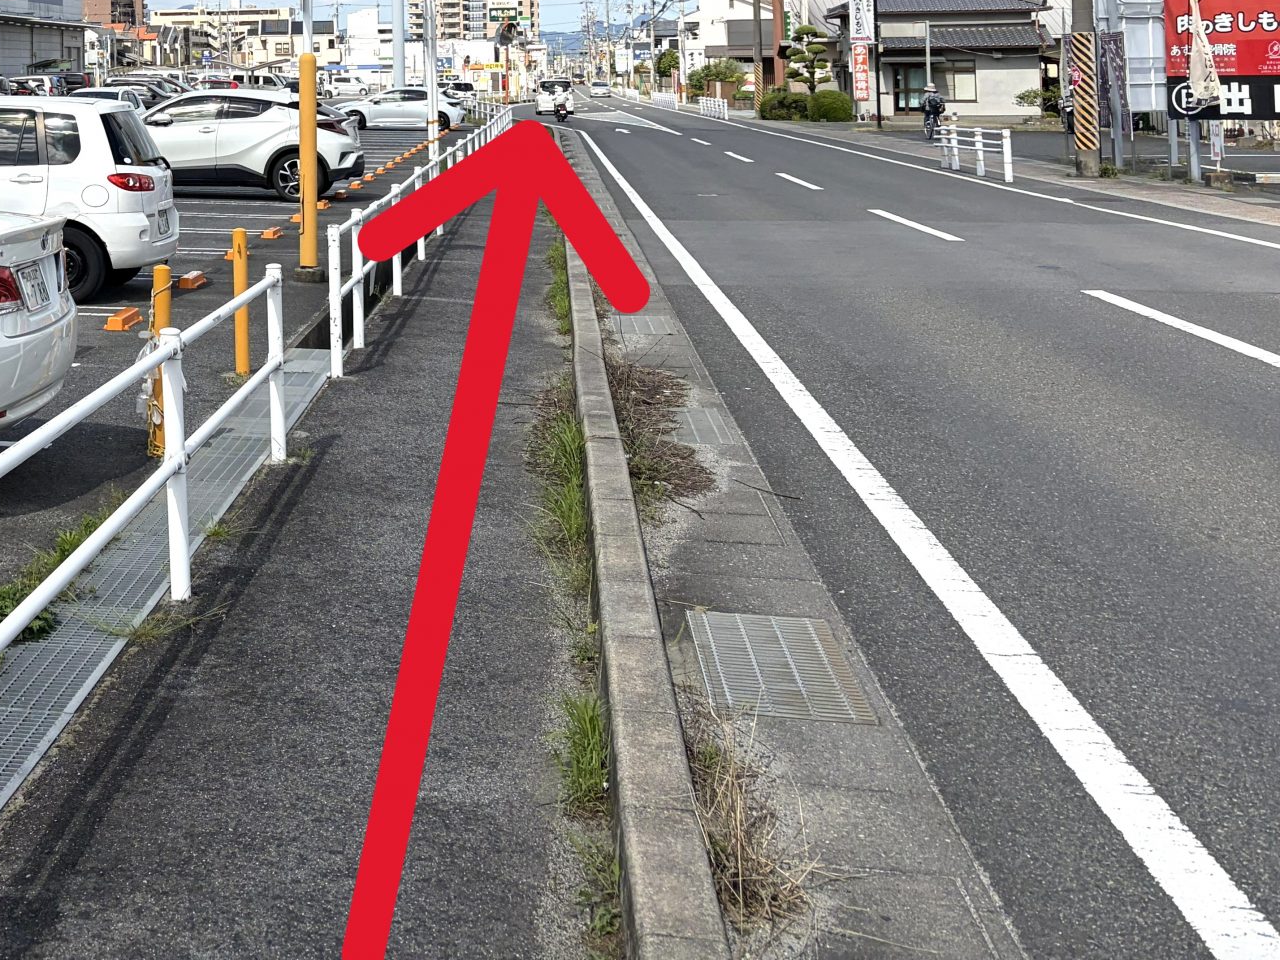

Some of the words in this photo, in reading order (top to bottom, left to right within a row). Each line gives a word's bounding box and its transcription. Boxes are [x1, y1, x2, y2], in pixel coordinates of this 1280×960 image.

[854, 46, 869, 99] あすか整骨院
